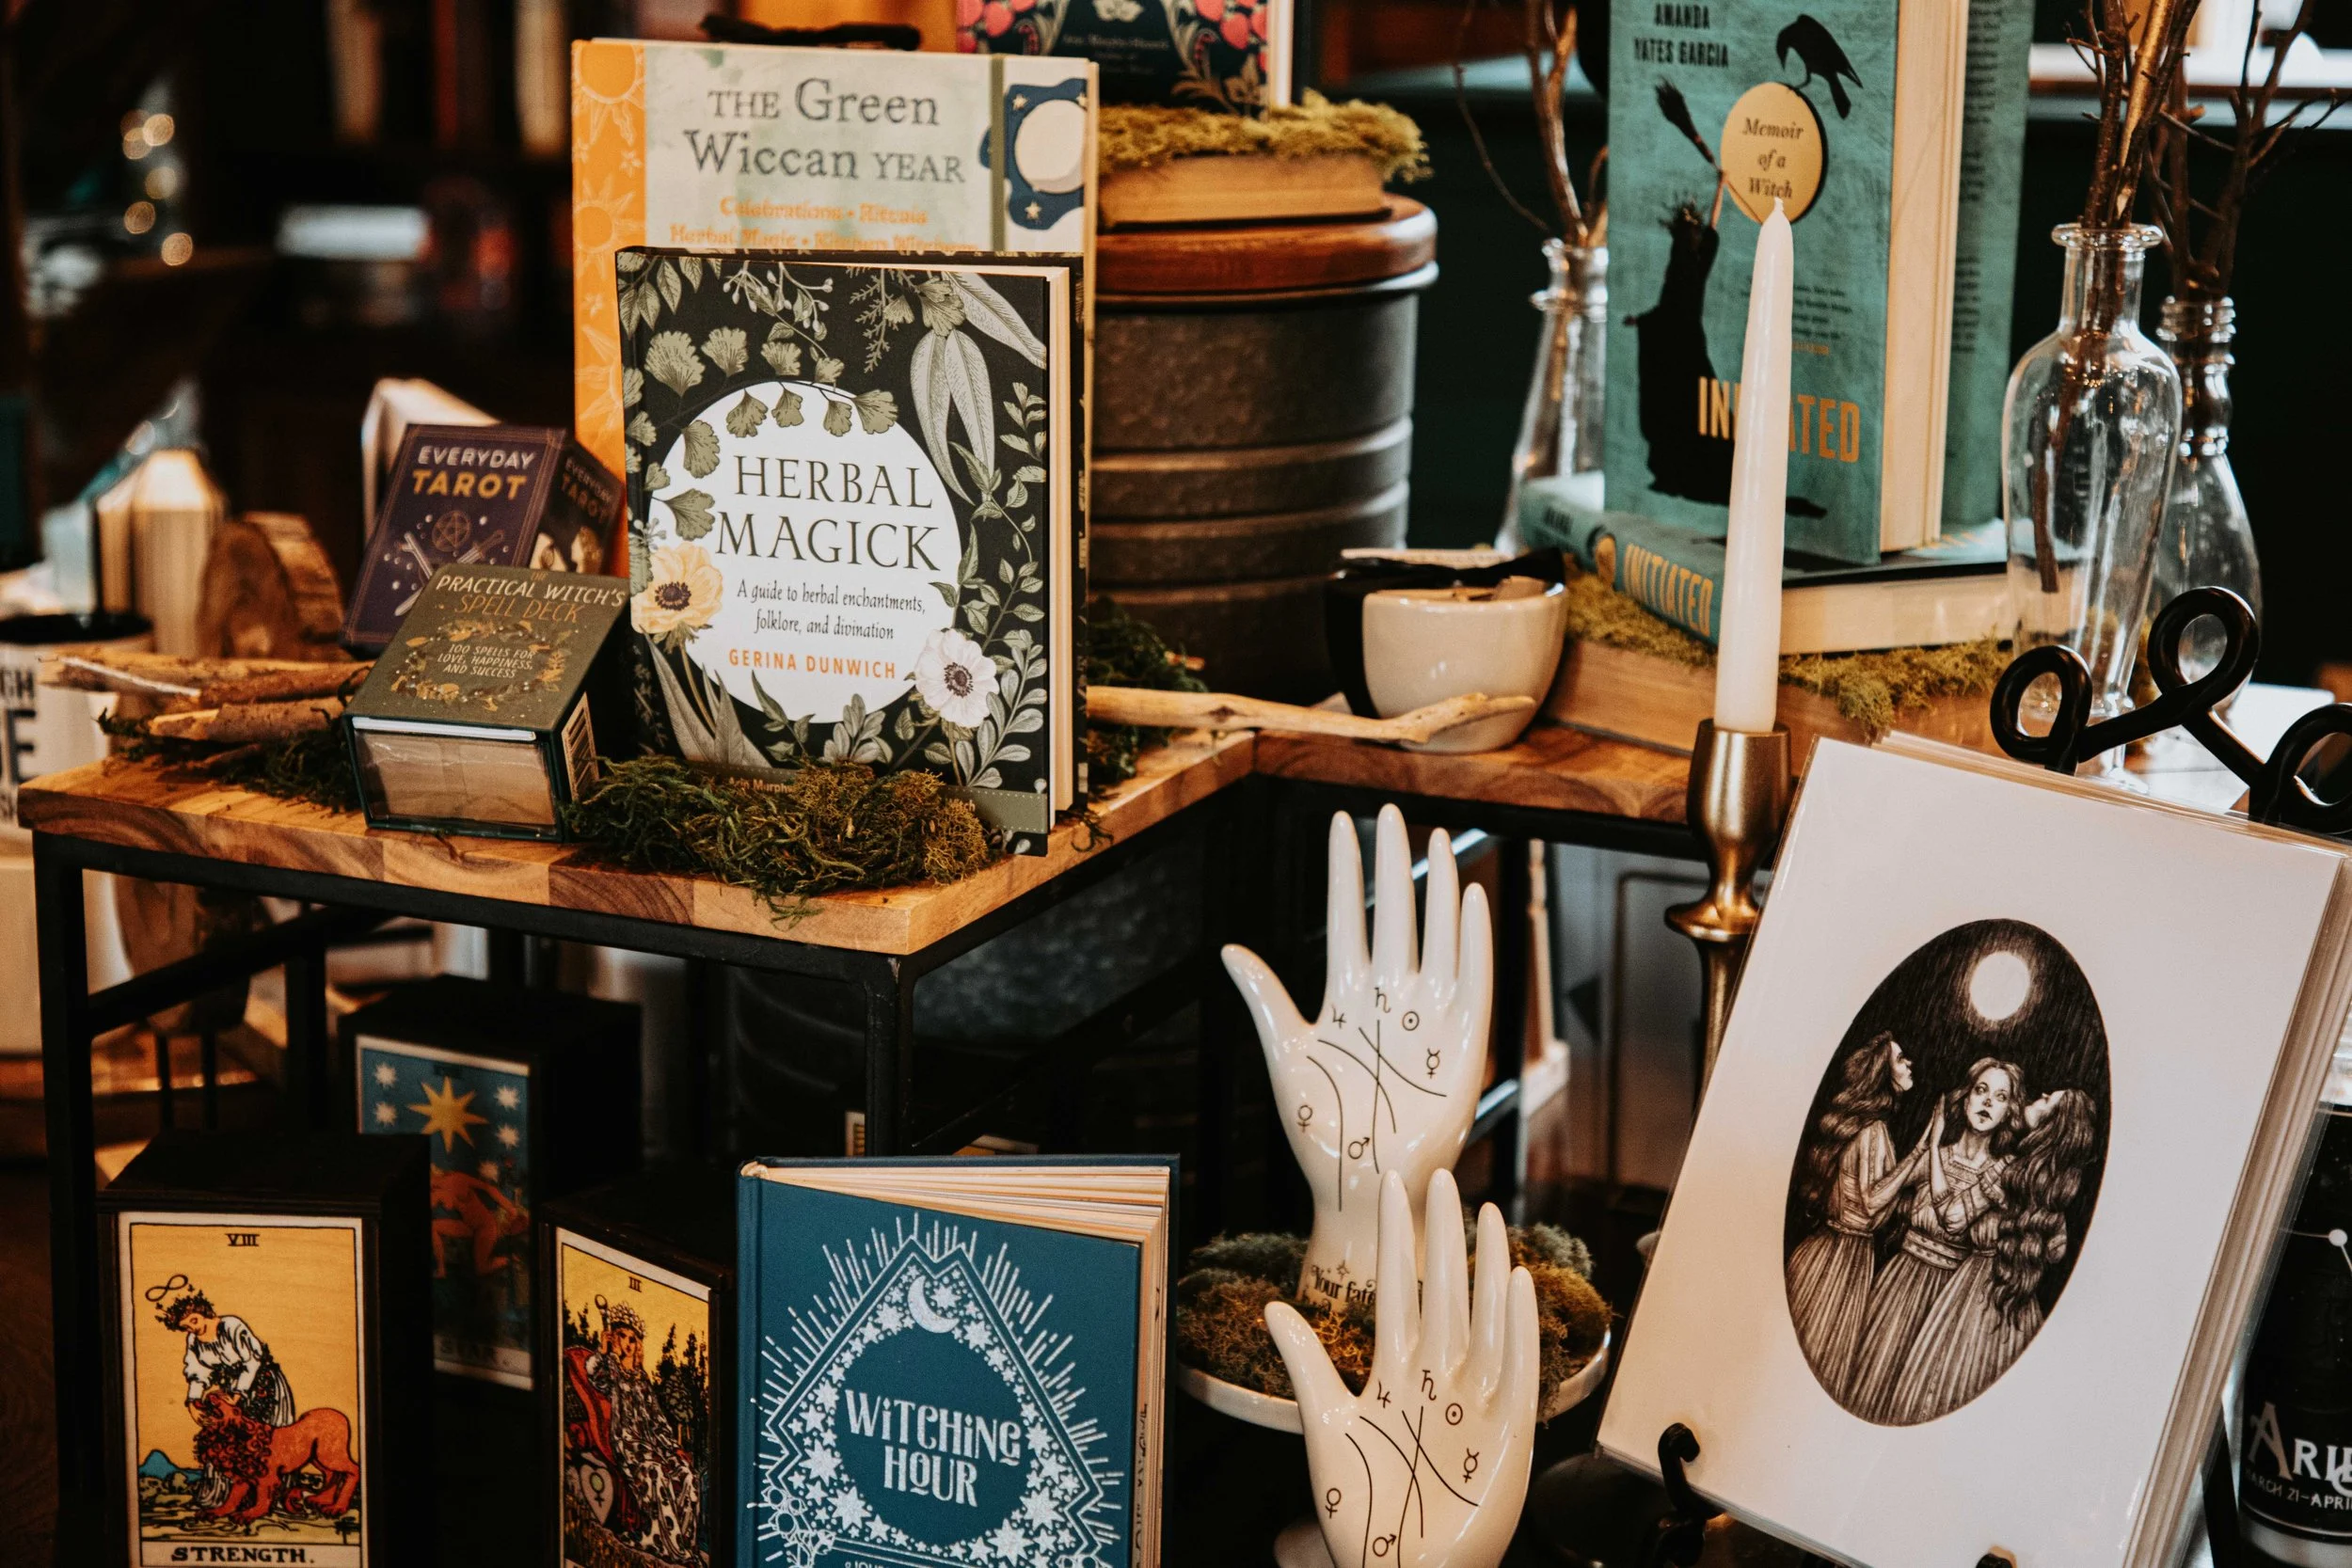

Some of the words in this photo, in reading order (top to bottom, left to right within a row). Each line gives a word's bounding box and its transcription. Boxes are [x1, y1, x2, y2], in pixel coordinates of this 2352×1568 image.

[1654, 3, 1710, 30] AMANDA
[1633, 38, 1674, 64] YATES
[1678, 41, 1729, 68] GARCIA
[707, 90, 782, 119] THE
[795, 77, 940, 126] Green
[1742, 117, 1804, 140] Memoir
[683, 129, 859, 181] Wiccan
[871, 150, 966, 183] YEAR
[1757, 149, 1776, 172] of
[1776, 153, 1787, 168] a
[1749, 177, 1793, 198] Witch
[417, 445, 537, 469] EVERYDAY
[412, 468, 528, 500] TAROT
[733, 454, 932, 509] HERBAL
[715, 511, 941, 571] MAGICK
[436, 574, 534, 598] PRACTICAL
[544, 584, 627, 609] WITCH'S
[737, 578, 748, 598] A
[751, 580, 783, 604] guide
[787, 584, 799, 602] to
[803, 581, 839, 606] herbal
[842, 590, 926, 614] enchantments,
[1624, 542, 1714, 638] INITIATED
[454, 594, 514, 617] SPELL
[521, 599, 587, 623] DECK
[754, 609, 802, 636] folklore,
[806, 614, 829, 634] and
[834, 616, 895, 640] divination
[437, 653, 467, 664] LOVE,
[471, 656, 534, 671] HAPPINESS,
[449, 643, 469, 654] 100
[473, 645, 509, 657] SPELLS
[516, 648, 537, 659] FOR
[728, 648, 798, 671] GERINA
[805, 655, 896, 679] DUNWICH
[442, 663, 468, 674] AND
[470, 665, 516, 679] SUCCESS
[225, 1233, 261, 1247] VIII
[628, 1275, 643, 1294] III
[1311, 1264, 1343, 1299] Your
[1345, 1278, 1377, 1306] fate
[882, 1445, 978, 1508] HOUR
[171, 1546, 315, 1564] STRENGTH.
